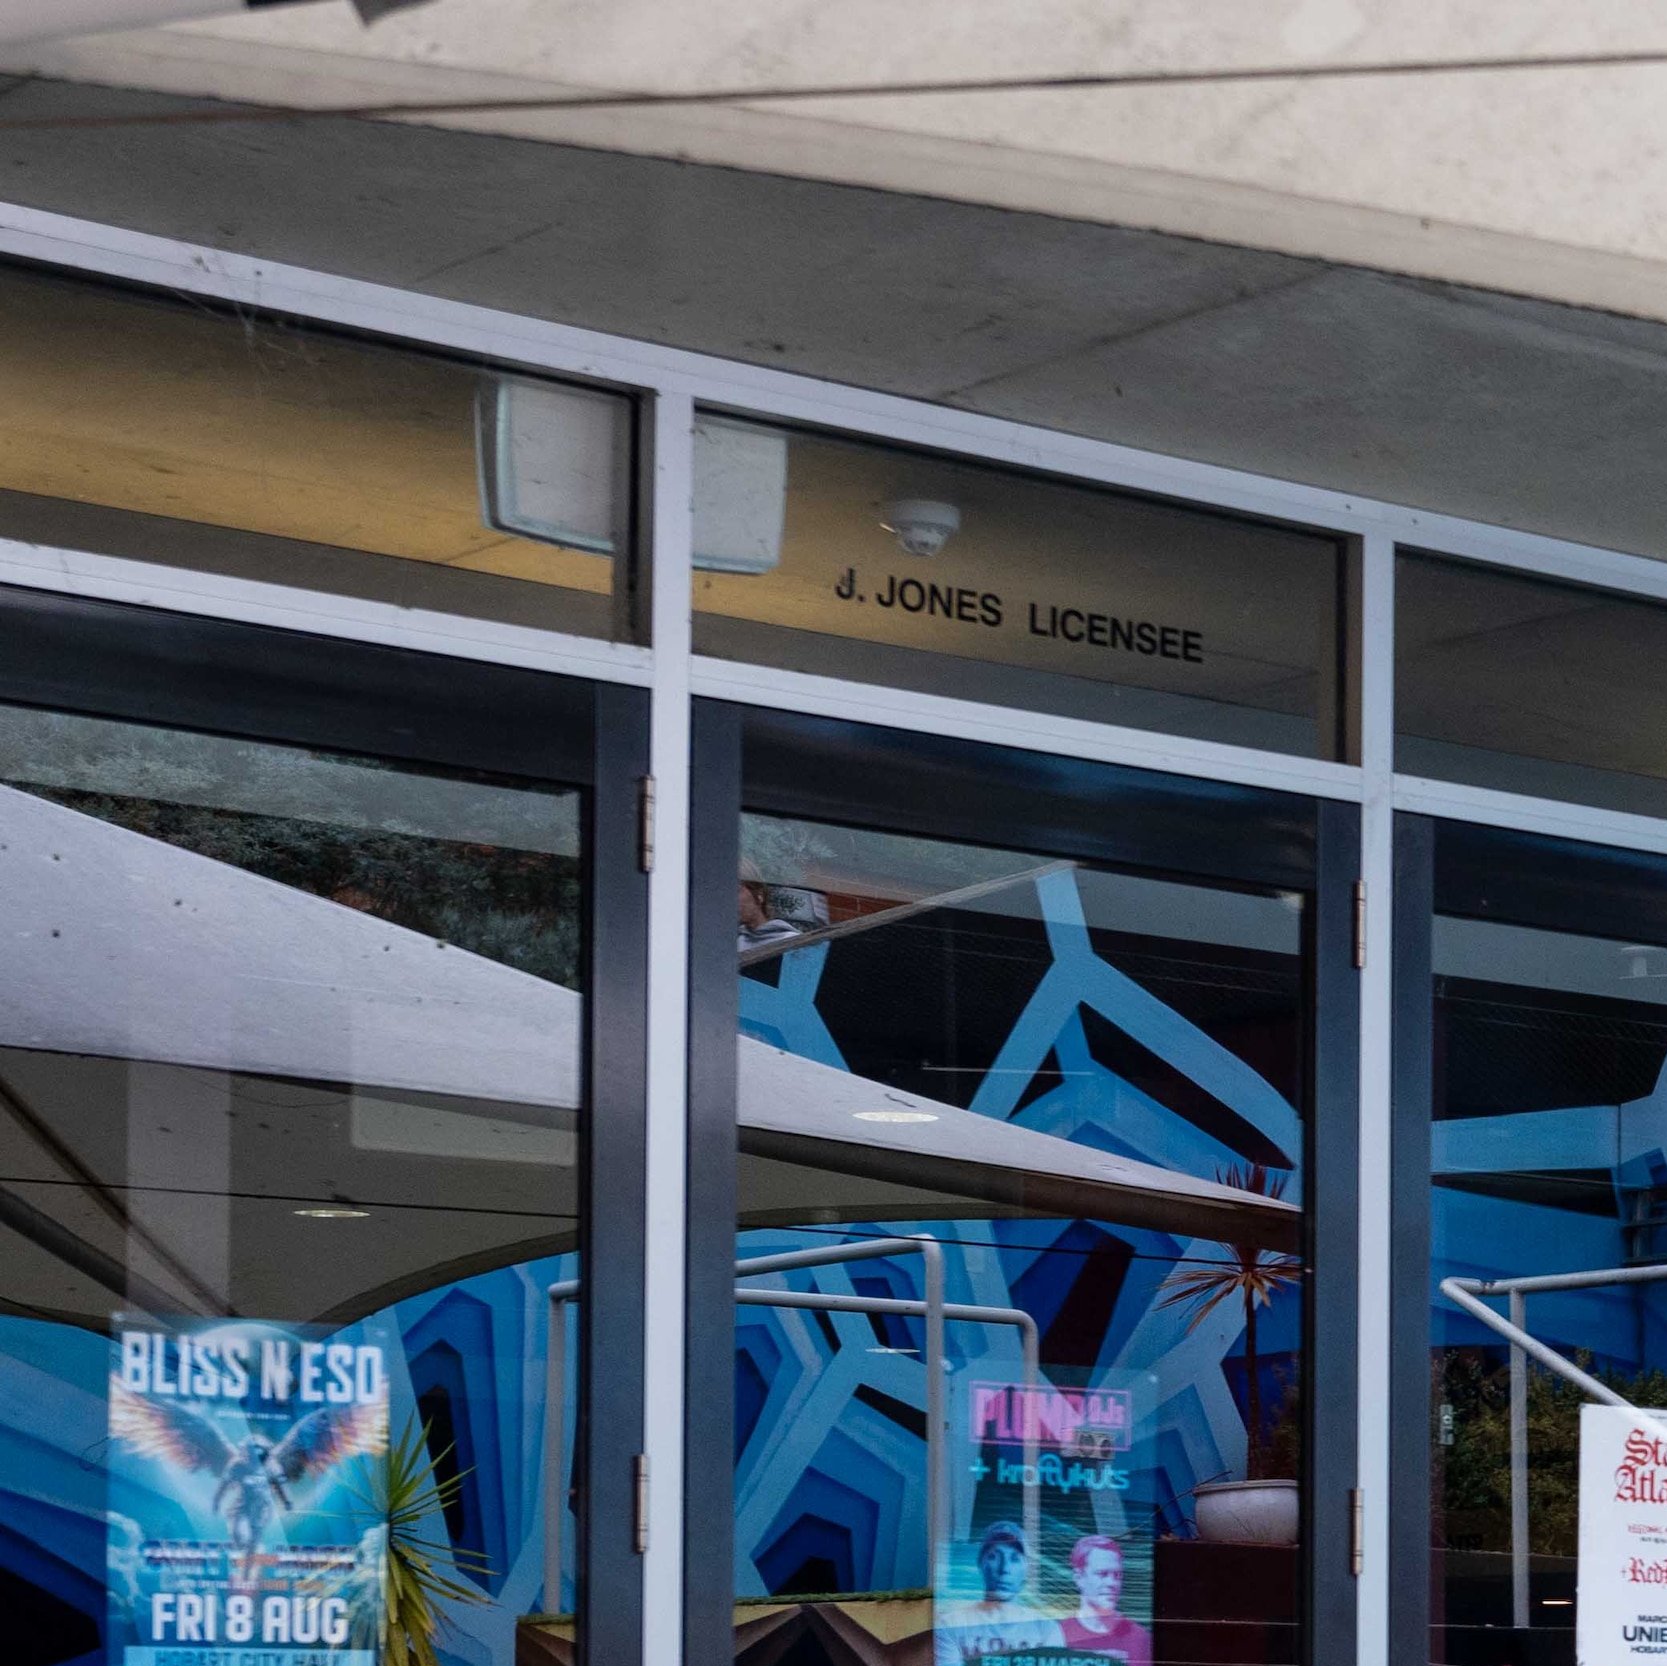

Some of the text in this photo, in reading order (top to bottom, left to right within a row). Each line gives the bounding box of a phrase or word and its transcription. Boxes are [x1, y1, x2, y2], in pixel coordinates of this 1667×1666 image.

[835, 568, 1204, 664] J. JONES LICENSEE
[121, 1331, 250, 1398] BLISS
[261, 1340, 289, 1401] N
[152, 1593, 350, 1644] FRI 8 AUG
